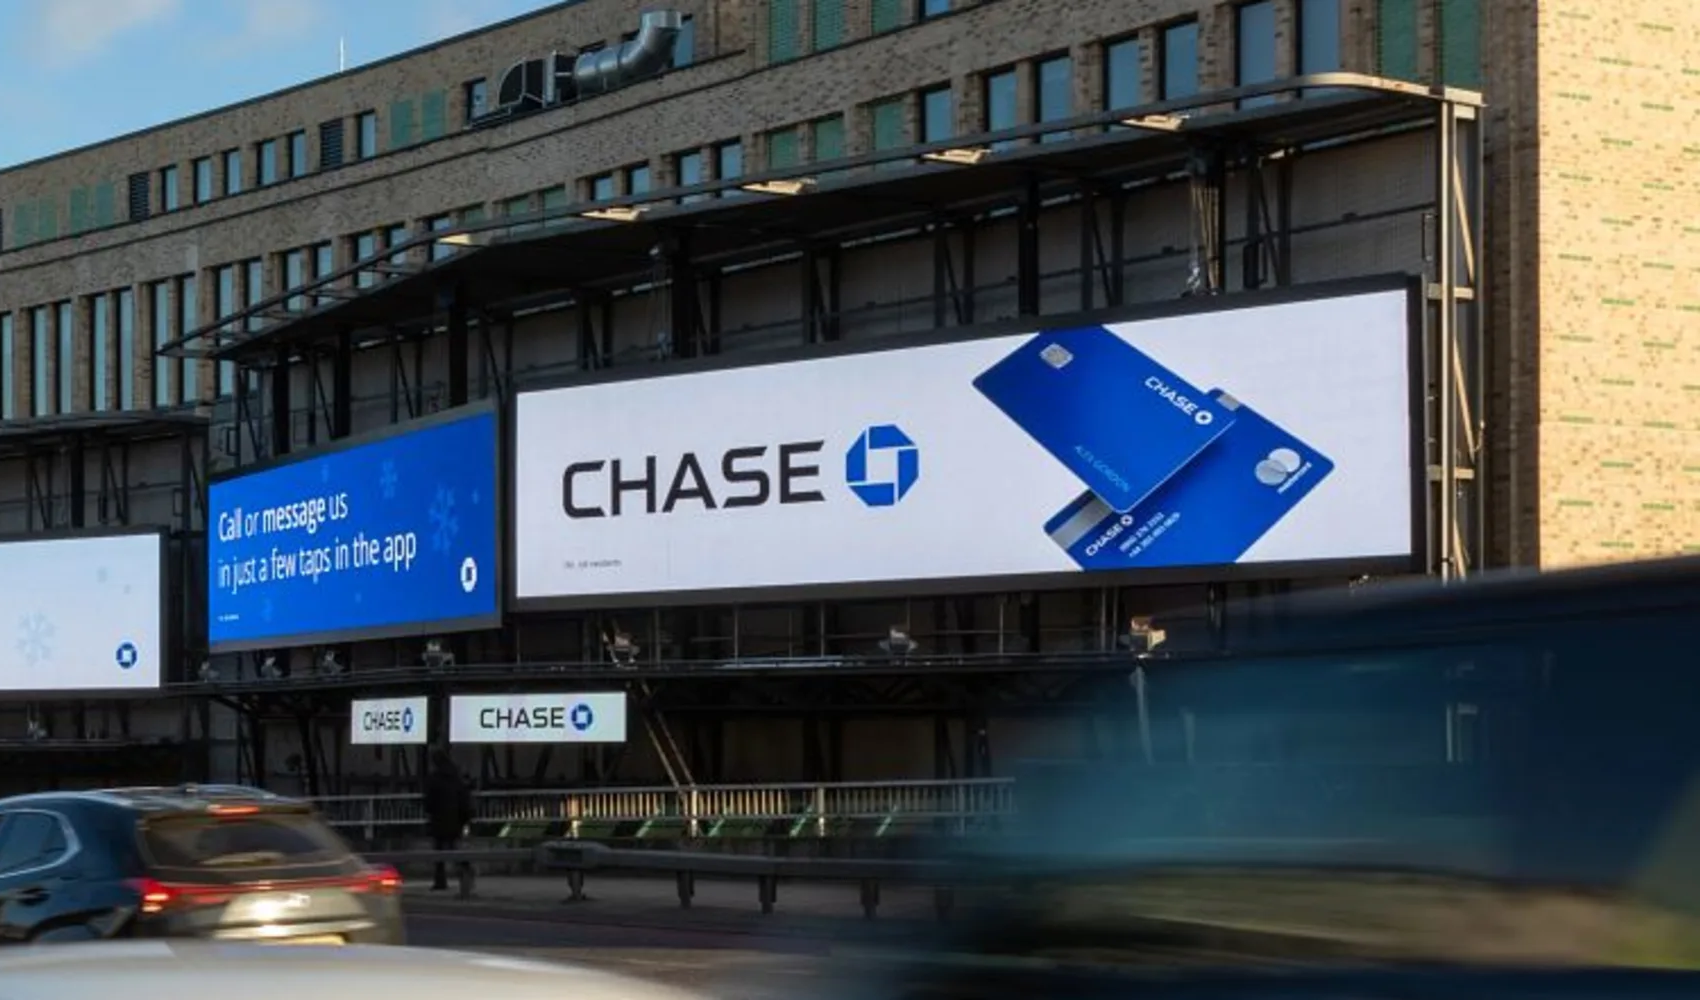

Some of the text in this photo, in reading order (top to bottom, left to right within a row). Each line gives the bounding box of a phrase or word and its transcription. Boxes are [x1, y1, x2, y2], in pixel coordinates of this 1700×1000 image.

[1145, 376, 1198, 416] CHASE
[563, 440, 825, 519] CHASE
[218, 492, 349, 542] Call or message us
[1086, 523, 1123, 557] CHASE
[218, 531, 416, 595] in just a few taps in the app
[363, 711, 400, 731] CHASE
[479, 707, 565, 729] CHASE
